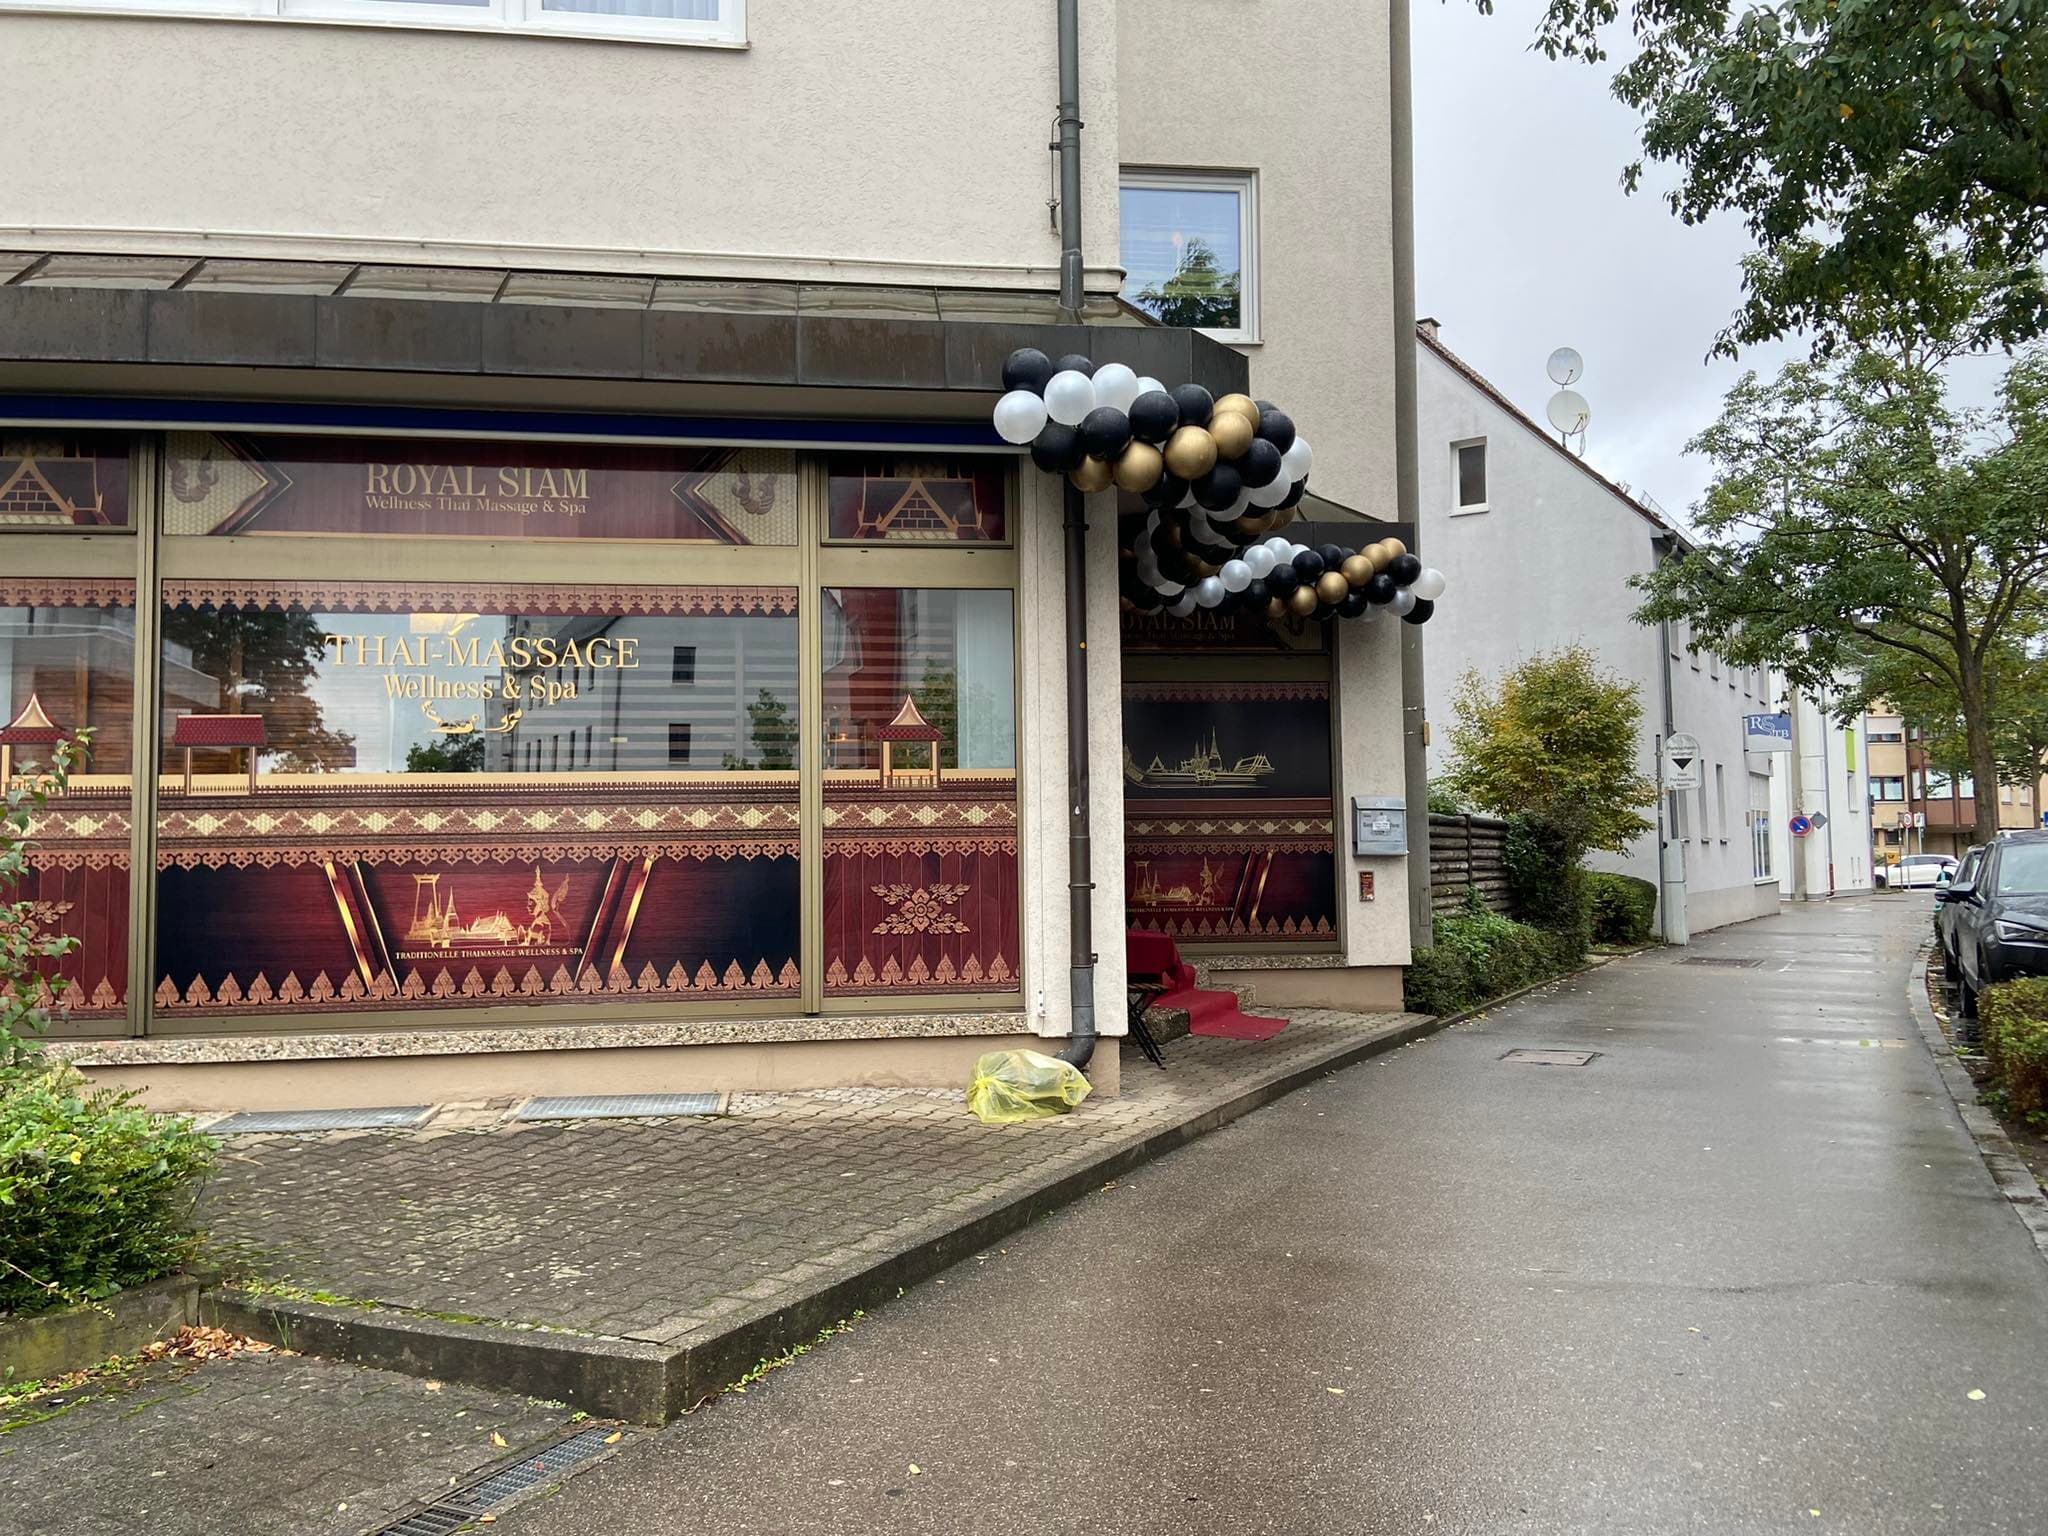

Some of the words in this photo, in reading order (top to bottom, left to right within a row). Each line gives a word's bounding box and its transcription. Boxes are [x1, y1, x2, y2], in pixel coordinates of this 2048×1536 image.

[365, 463, 486, 496] ROYAL
[498, 466, 590, 499] SIAM
[365, 496, 432, 510] Wellness
[437, 497, 471, 511] Thai
[476, 498, 538, 515] Massage
[543, 500, 555, 513] &
[559, 500, 586, 516] Spa
[1182, 610, 1236, 631] SIAM
[325, 634, 640, 669] THAI-MASSAGE
[384, 673, 494, 700] Wellness
[502, 675, 523, 700] &
[530, 675, 578, 706] Spa
[395, 951, 459, 960] TRADITIONELLE
[461, 950, 515, 959] THAIMASSAGE
[518, 948, 560, 957] WELLNESS
[569, 947, 583, 955] SPA
